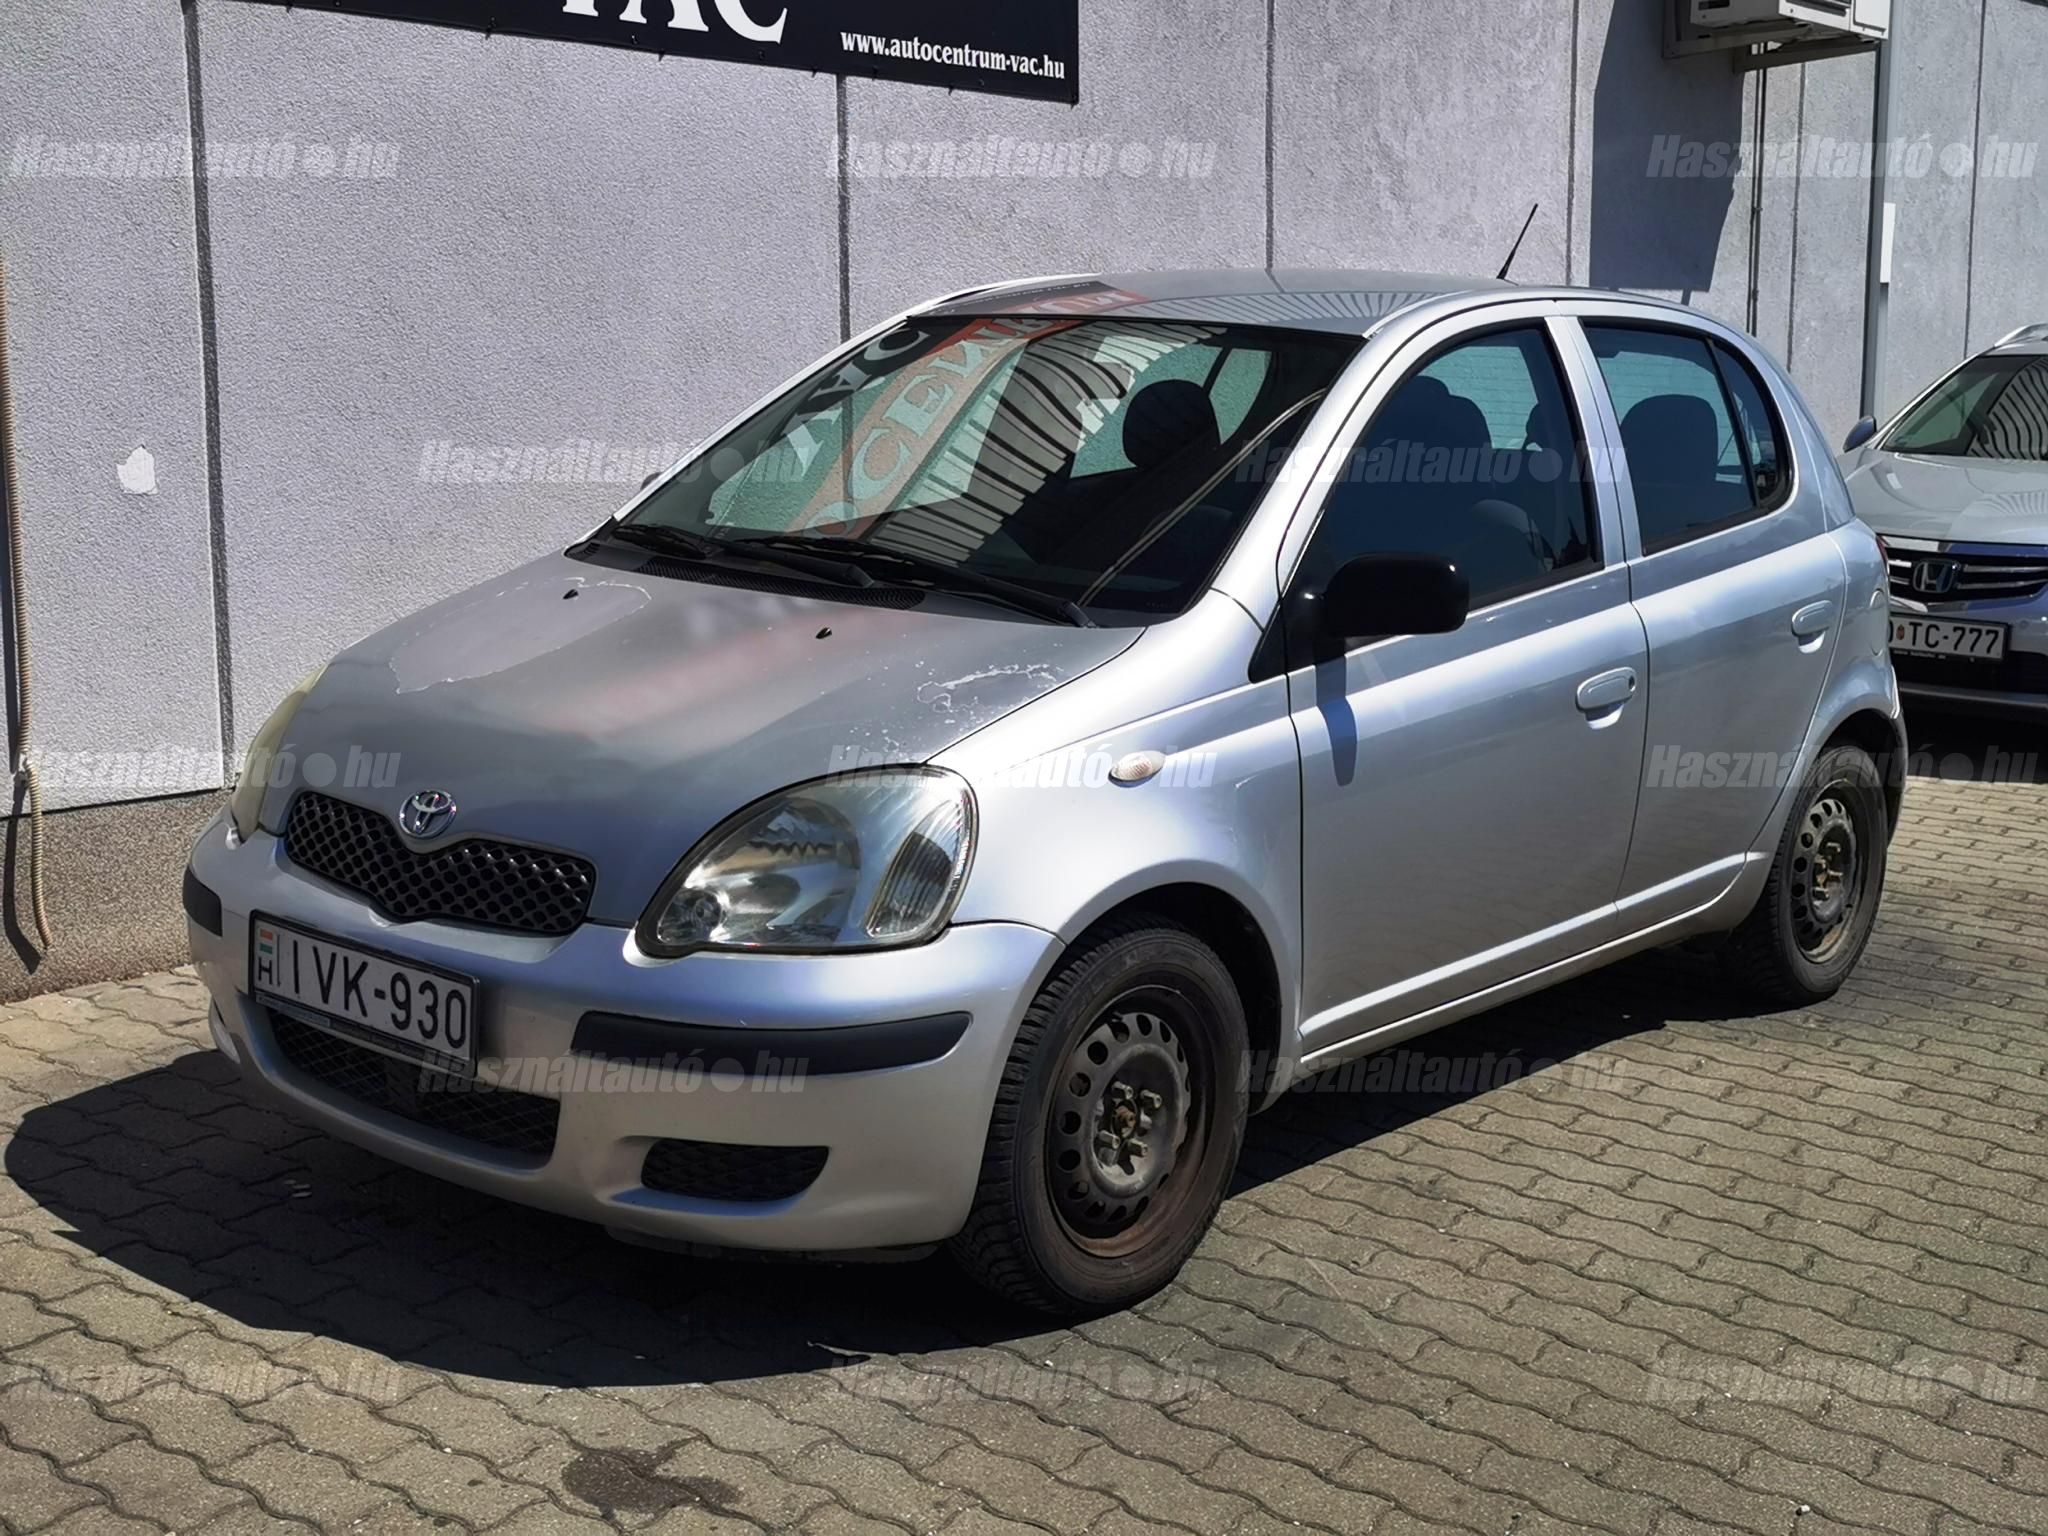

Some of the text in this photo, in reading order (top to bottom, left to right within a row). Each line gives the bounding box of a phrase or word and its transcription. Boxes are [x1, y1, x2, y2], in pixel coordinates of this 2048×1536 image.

[840, 31, 1065, 79] www.autocentrum-vac.hu
[257, 956, 273, 985] H
[292, 940, 467, 1050] IVK-930
